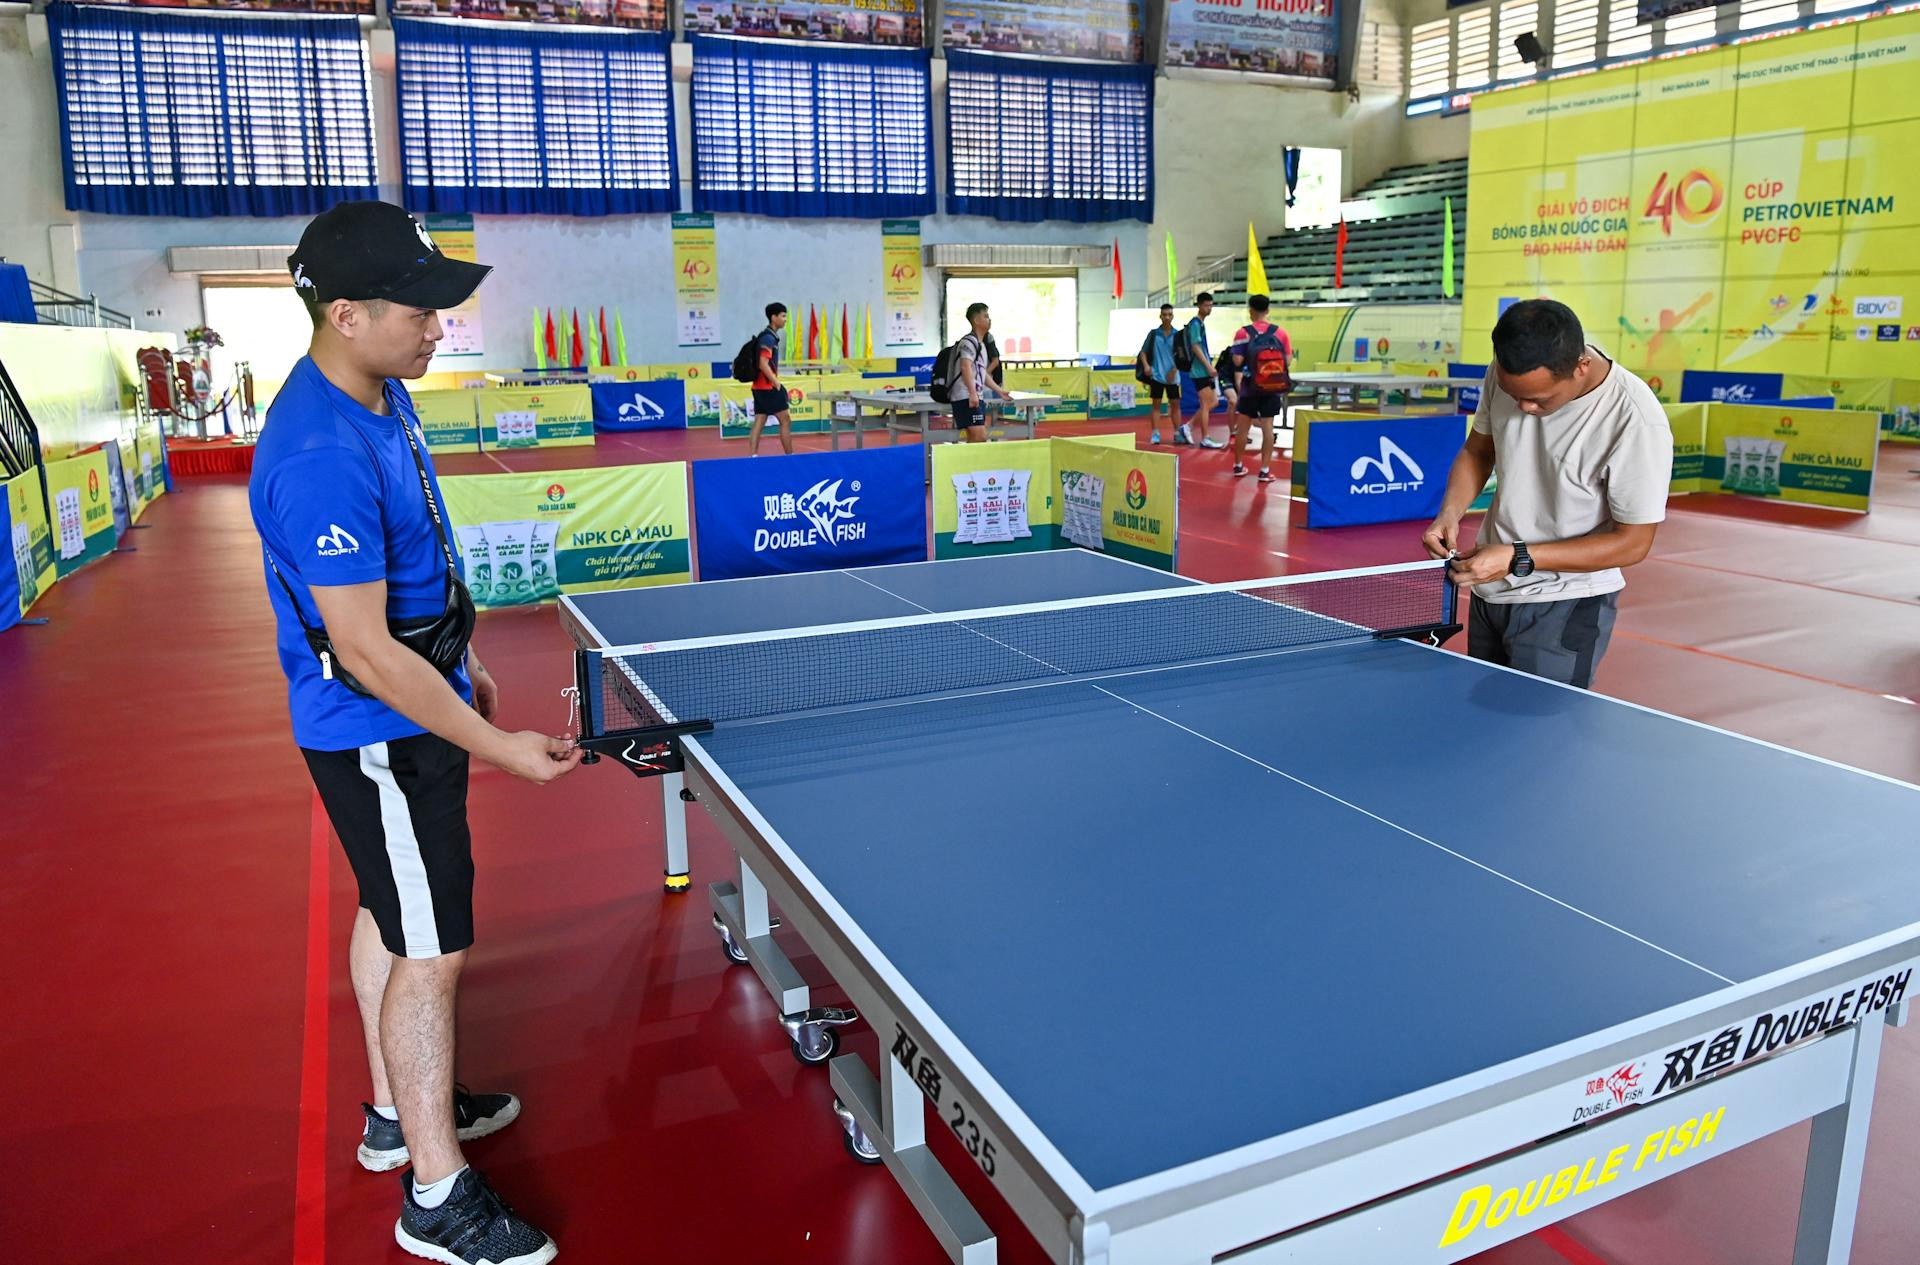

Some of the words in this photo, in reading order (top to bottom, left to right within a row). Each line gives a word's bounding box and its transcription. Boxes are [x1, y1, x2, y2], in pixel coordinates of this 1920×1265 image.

[1887, 45, 1907, 56] NAM
[1744, 178, 1783, 200] CÚP
[1537, 200, 1564, 219] GIẢI
[1569, 196, 1588, 215] VÔ
[1592, 195, 1629, 214] ĐỊCH
[1644, 169, 1724, 238] 40
[1743, 195, 1895, 222] PETROVIETNAM
[1492, 223, 1528, 241] BÓNG
[1530, 219, 1558, 238] BÀN
[1560, 214, 1600, 237] QUỐC
[1603, 217, 1628, 233] GIA
[1741, 226, 1802, 245] PVCFC
[1523, 241, 1550, 257] BÁO
[1552, 239, 1593, 255] NHÂN
[1596, 236, 1627, 253] DÂN
[1856, 302, 1886, 315] BIDV
[619, 413, 664, 423] MOFIT
[1792, 452, 1814, 464] NPK
[1817, 452, 1833, 465] CÀ
[1836, 455, 1862, 467] MAU
[1350, 481, 1424, 495] MOFIT
[983, 499, 1003, 509] KALI
[573, 531, 606, 546] NPK
[611, 525, 633, 543] CÀ
[636, 524, 673, 541] MAU
[754, 528, 817, 552] DOUBLE
[836, 522, 866, 542] FISH
[318, 547, 360, 557] MOFIT
[507, 569, 517, 580] N
[639, 752, 657, 761] DOUBLE
[1651, 1026, 1743, 1097] 双鱼
[1742, 989, 1856, 1063] DOUBLE
[1852, 968, 1913, 1020] FISH
[1573, 1098, 1612, 1122] DOUBLE
[1624, 1087, 1644, 1104] FISH
[950, 1101, 997, 1178] 235
[1438, 1144, 1630, 1249] DOUBLE
[1632, 1106, 1726, 1172] FISH
